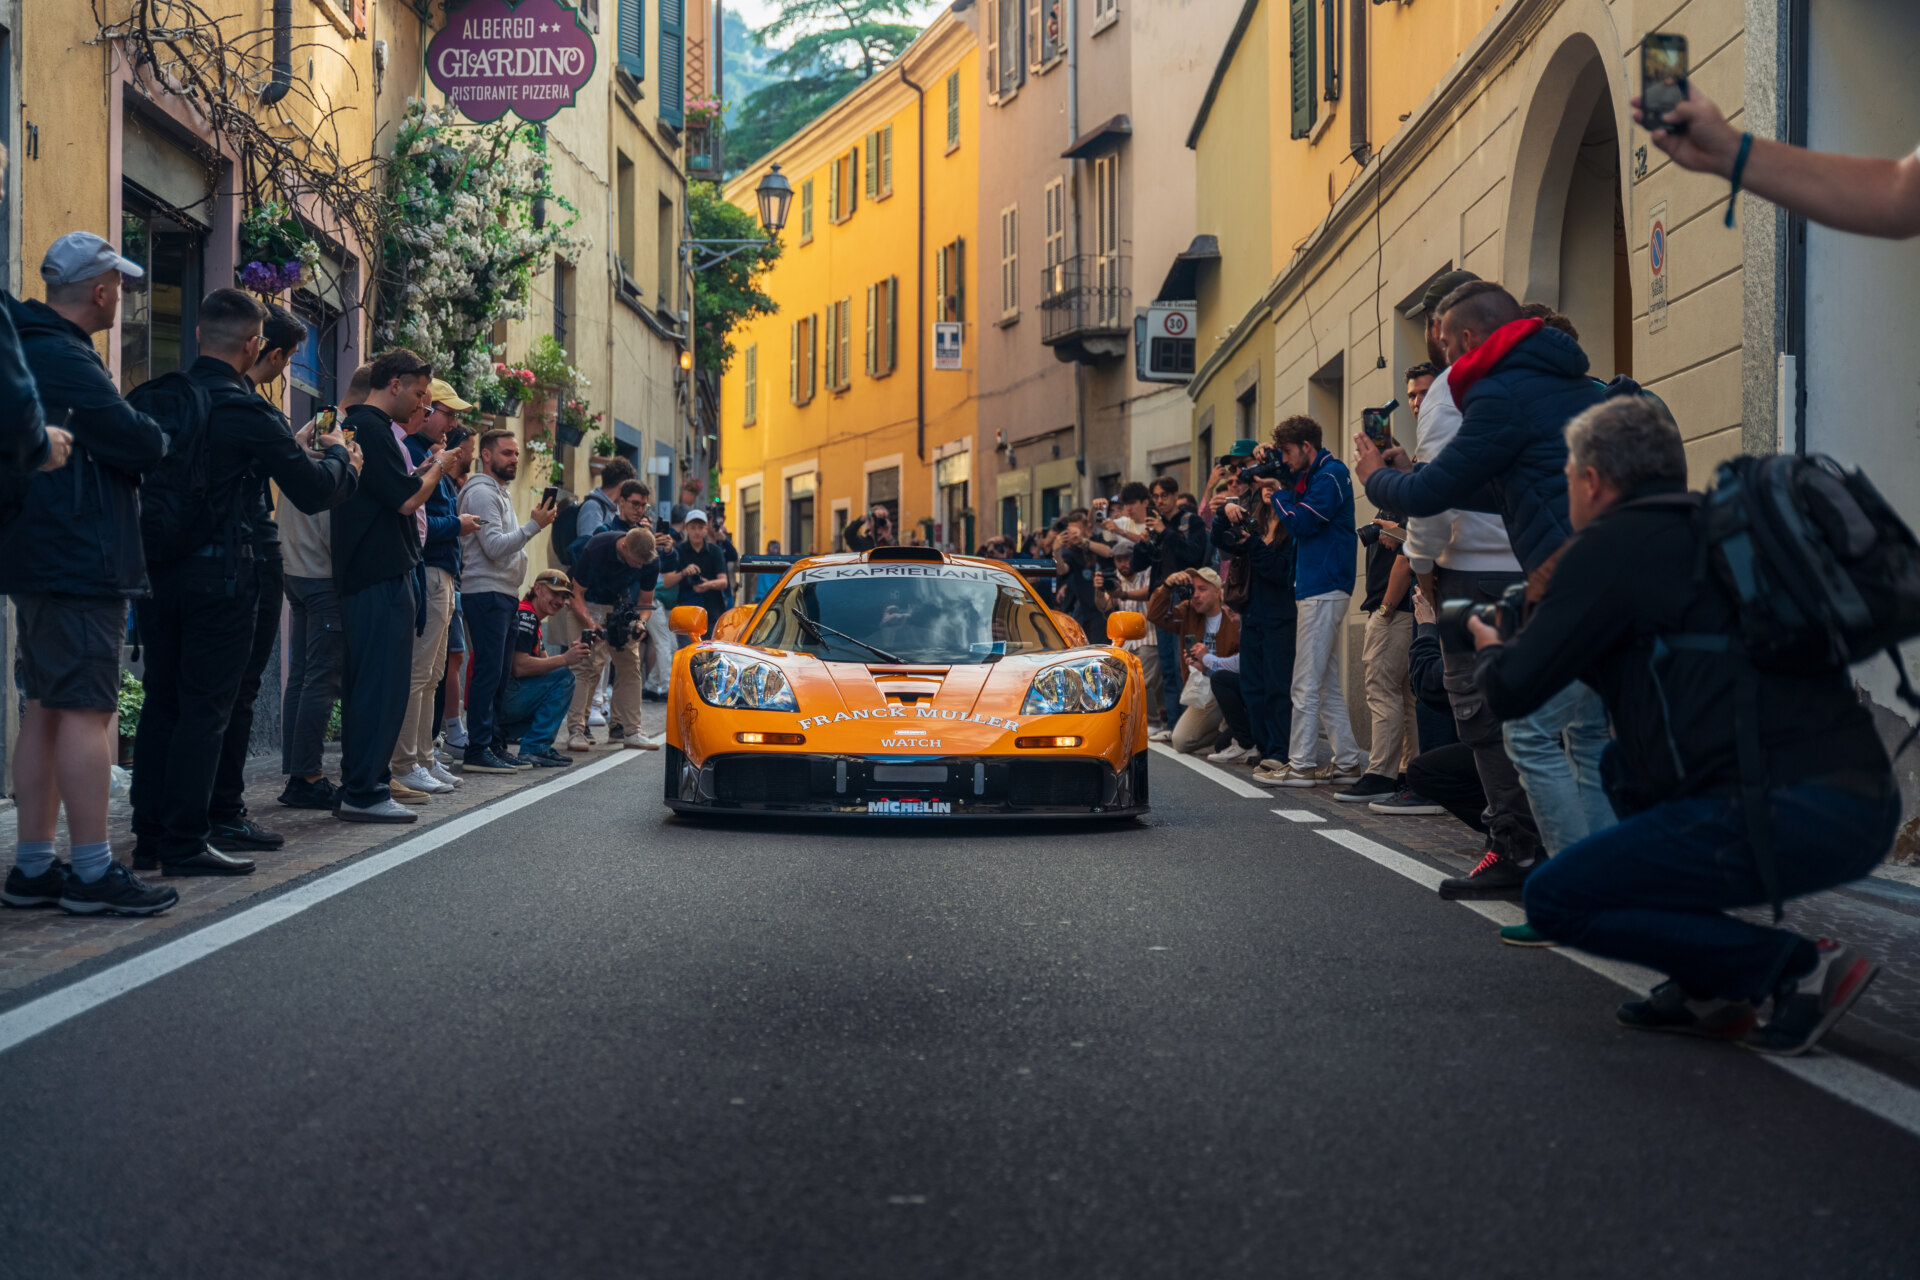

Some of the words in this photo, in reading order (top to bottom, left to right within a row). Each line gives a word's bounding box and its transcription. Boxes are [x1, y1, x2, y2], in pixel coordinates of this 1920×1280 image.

[462, 17, 534, 40] ALBERGO
[438, 47, 585, 78] GIARDINO
[451, 85, 518, 101] RISTORANTE
[522, 84, 570, 100] PIZZERIA
[1169, 318, 1183, 329] 30
[836, 567, 977, 581] KAPRIELIAN
[797, 707, 907, 731] FRANCK
[916, 708, 1020, 733] MULLER
[880, 738, 942, 748] WATCH
[867, 800, 951, 814] MICHELIN
